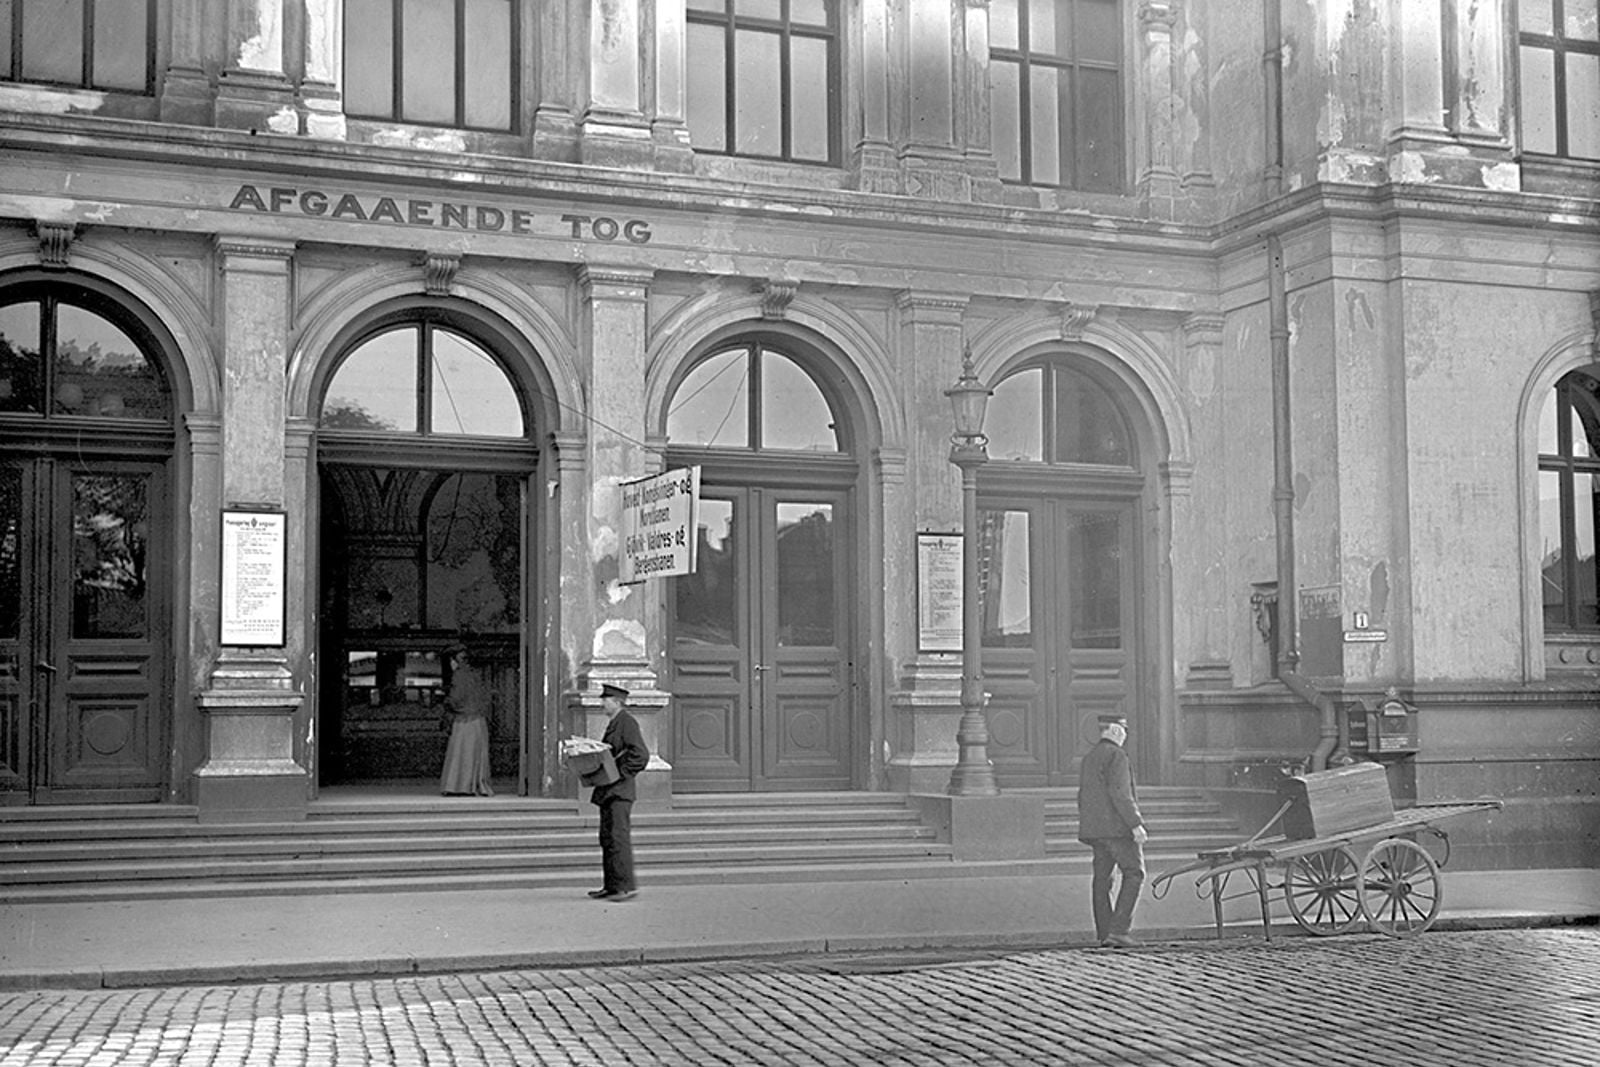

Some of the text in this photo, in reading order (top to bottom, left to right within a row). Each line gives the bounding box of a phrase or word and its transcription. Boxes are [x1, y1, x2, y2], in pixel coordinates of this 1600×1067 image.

[229, 184, 652, 244] AFGAAENDE TOG
[675, 525, 686, 548] og
